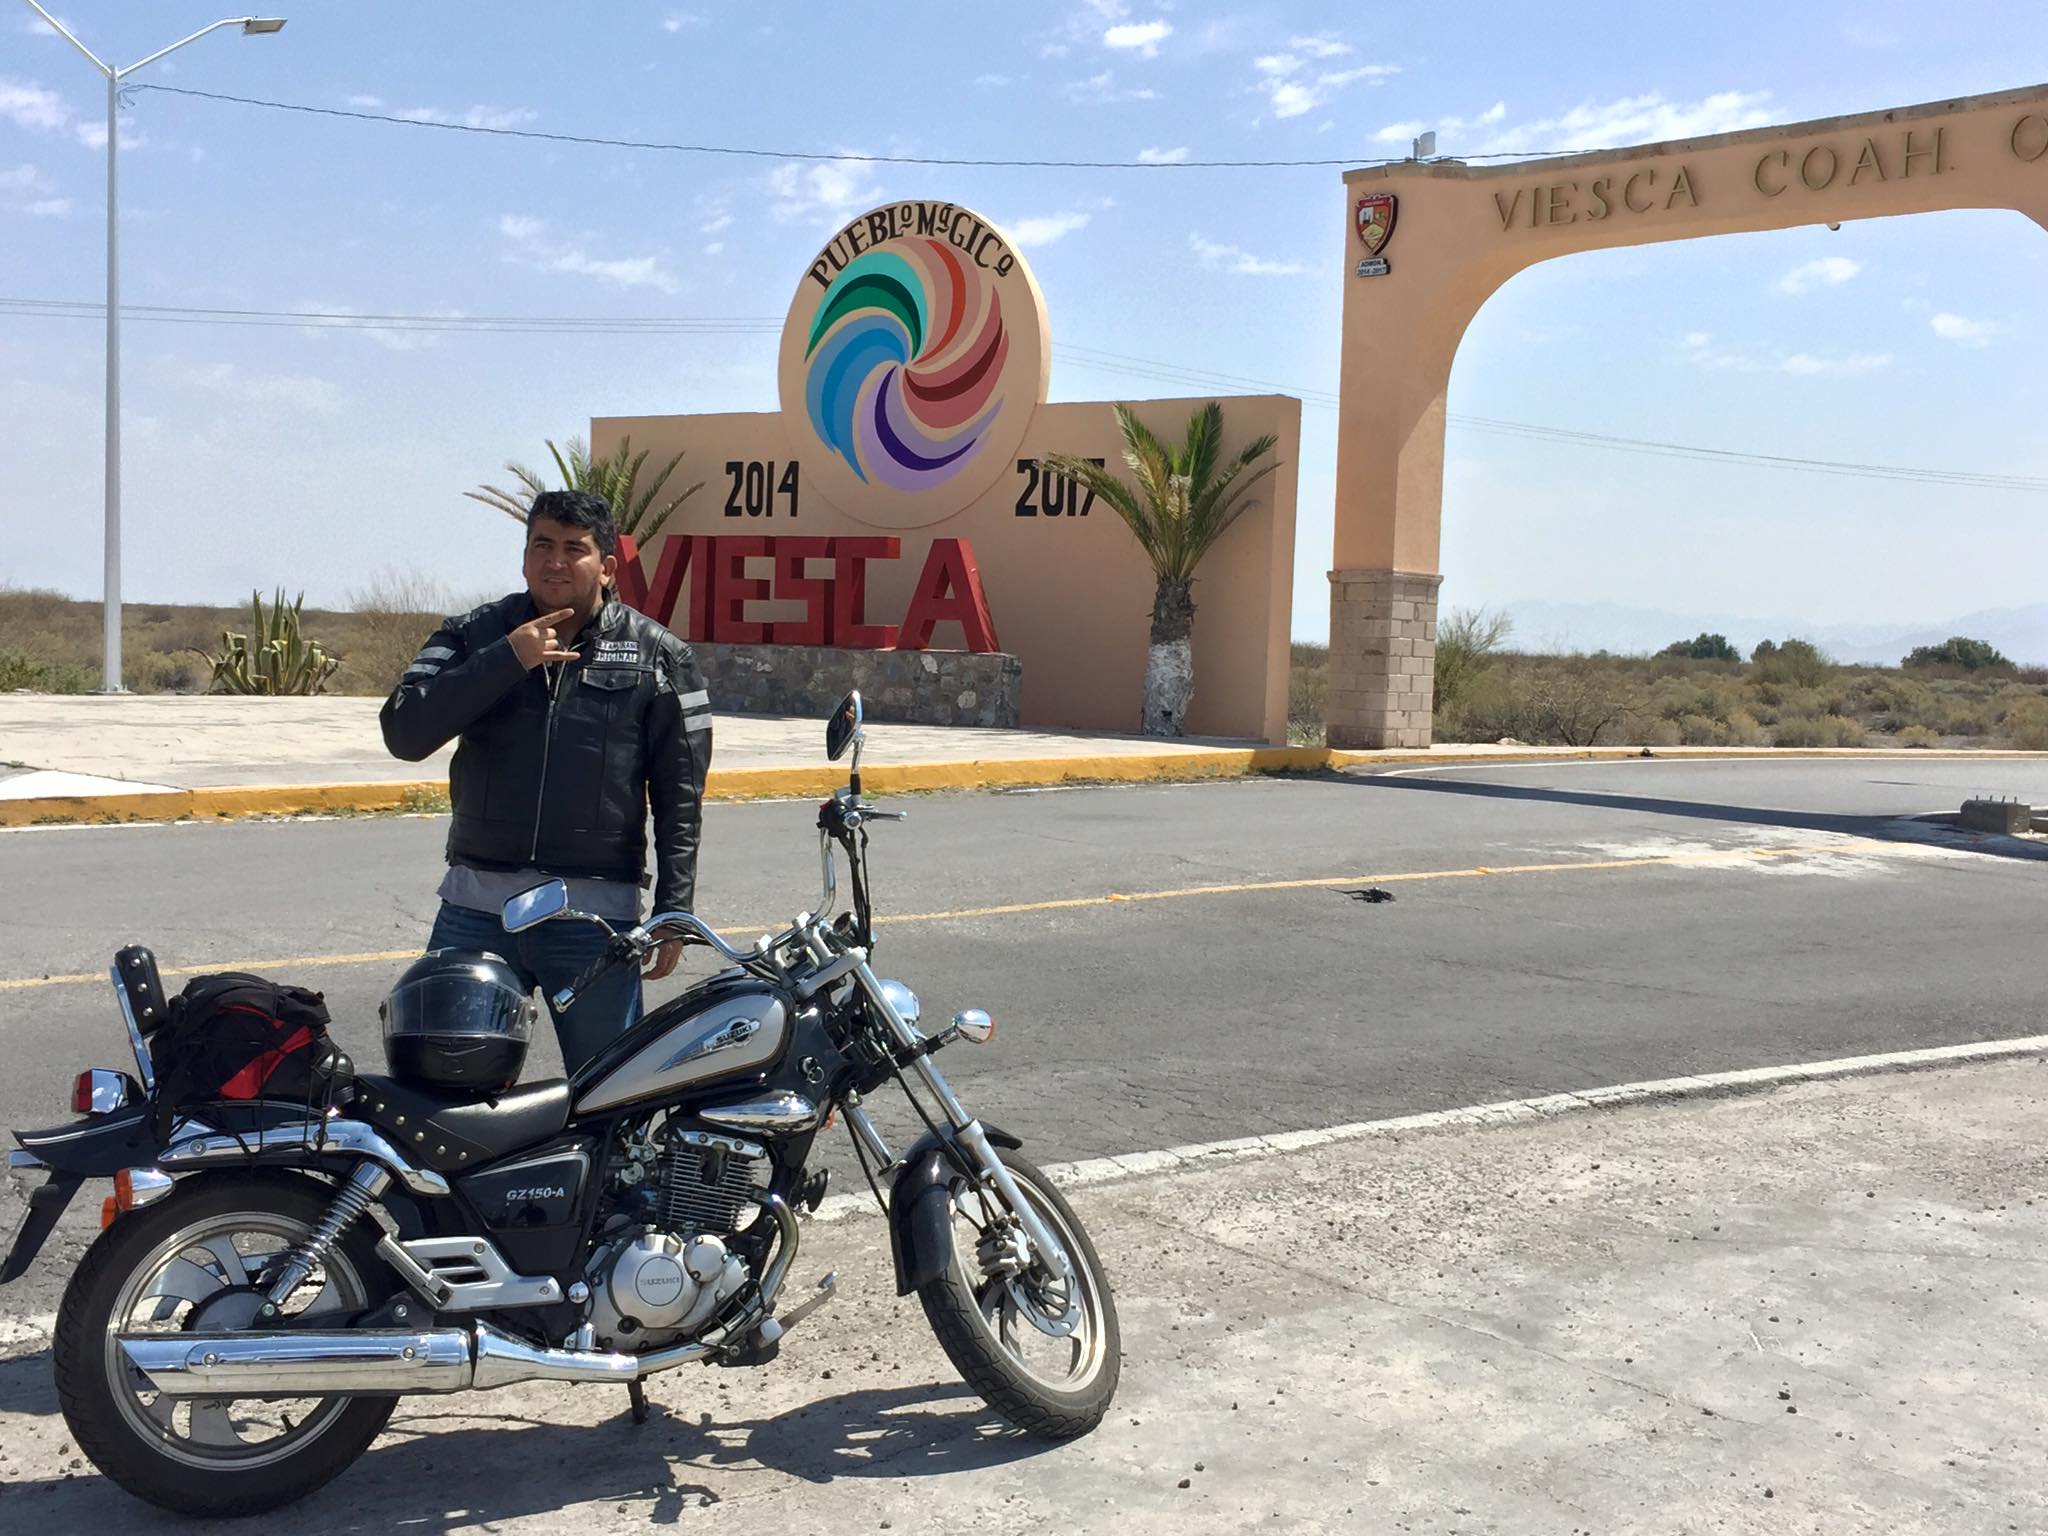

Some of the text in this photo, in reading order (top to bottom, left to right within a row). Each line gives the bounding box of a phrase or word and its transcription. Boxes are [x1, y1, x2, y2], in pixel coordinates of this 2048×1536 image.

[1494, 165, 1699, 232] VIESCA
[1754, 127, 1956, 198] COAH.
[725, 461, 799, 517] 2014
[1015, 458, 1105, 516] 2017
[614, 535, 1000, 654] VIESCA
[716, 1024, 752, 1043] SUZUKI
[506, 1187, 564, 1200] GZ150-A
[640, 1277, 680, 1286] SUZUKI
